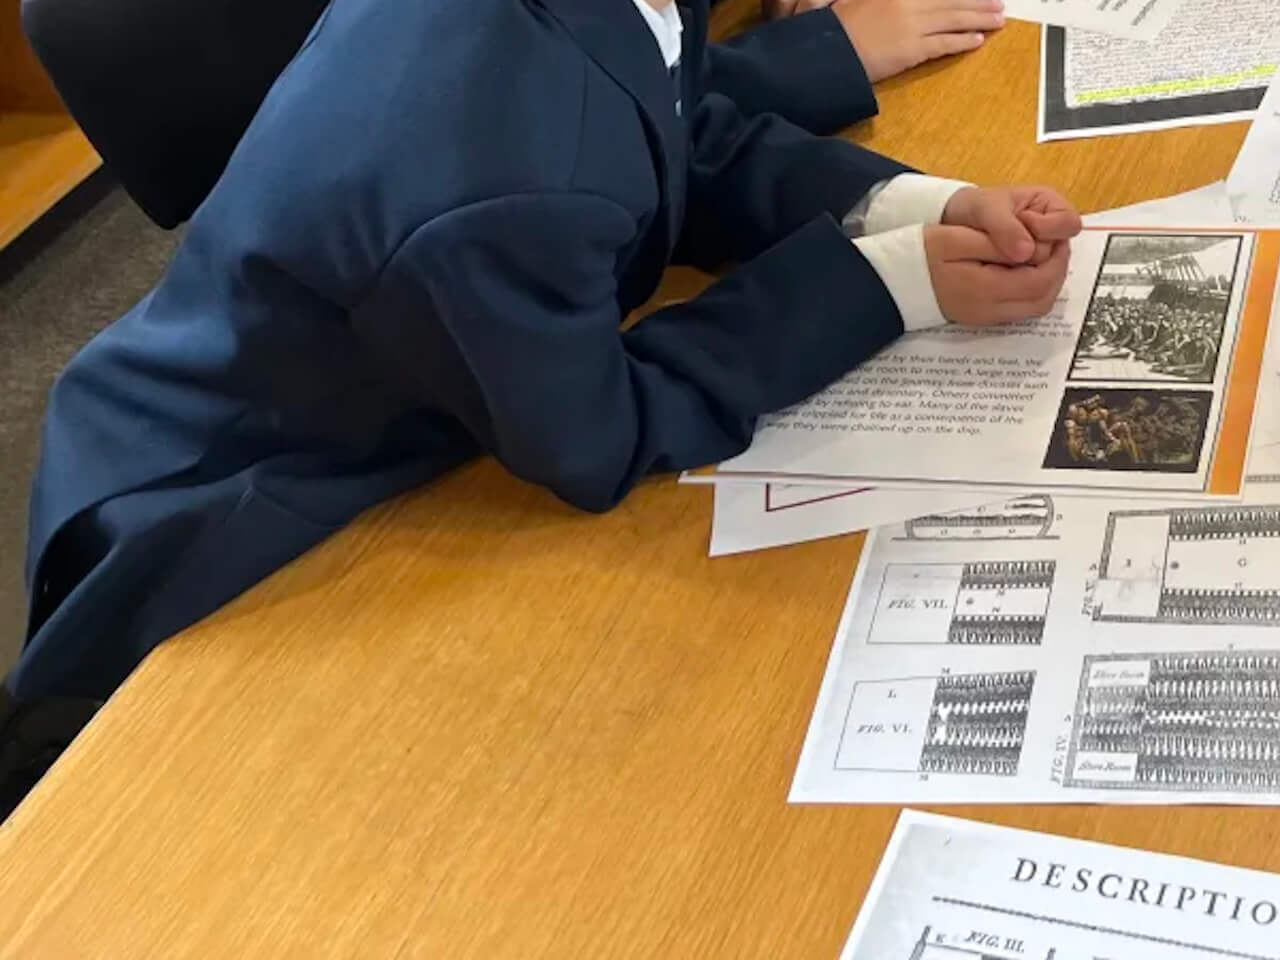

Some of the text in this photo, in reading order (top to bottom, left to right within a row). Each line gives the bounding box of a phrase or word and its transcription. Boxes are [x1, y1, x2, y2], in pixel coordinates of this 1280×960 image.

[938, 355, 970, 365] hands
[973, 356, 995, 365] and
[1025, 358, 1044, 366] the
[876, 366, 907, 374] room
[910, 366, 923, 375] to
[976, 368, 1004, 378] large
[1006, 368, 1049, 378] number
[862, 377, 878, 385] on
[880, 376, 898, 385] the
[1024, 380, 1049, 390] such
[931, 390, 970, 399] Others
[972, 392, 1035, 401] committed
[919, 400, 952, 411] Many
[955, 400, 968, 410] of
[970, 401, 989, 410] the
[914, 414, 987, 423] consequence
[1004, 416, 1025, 424] the
[857, 723, 913, 734] FIG. VI.
[965, 929, 1025, 953] FIG. III.
